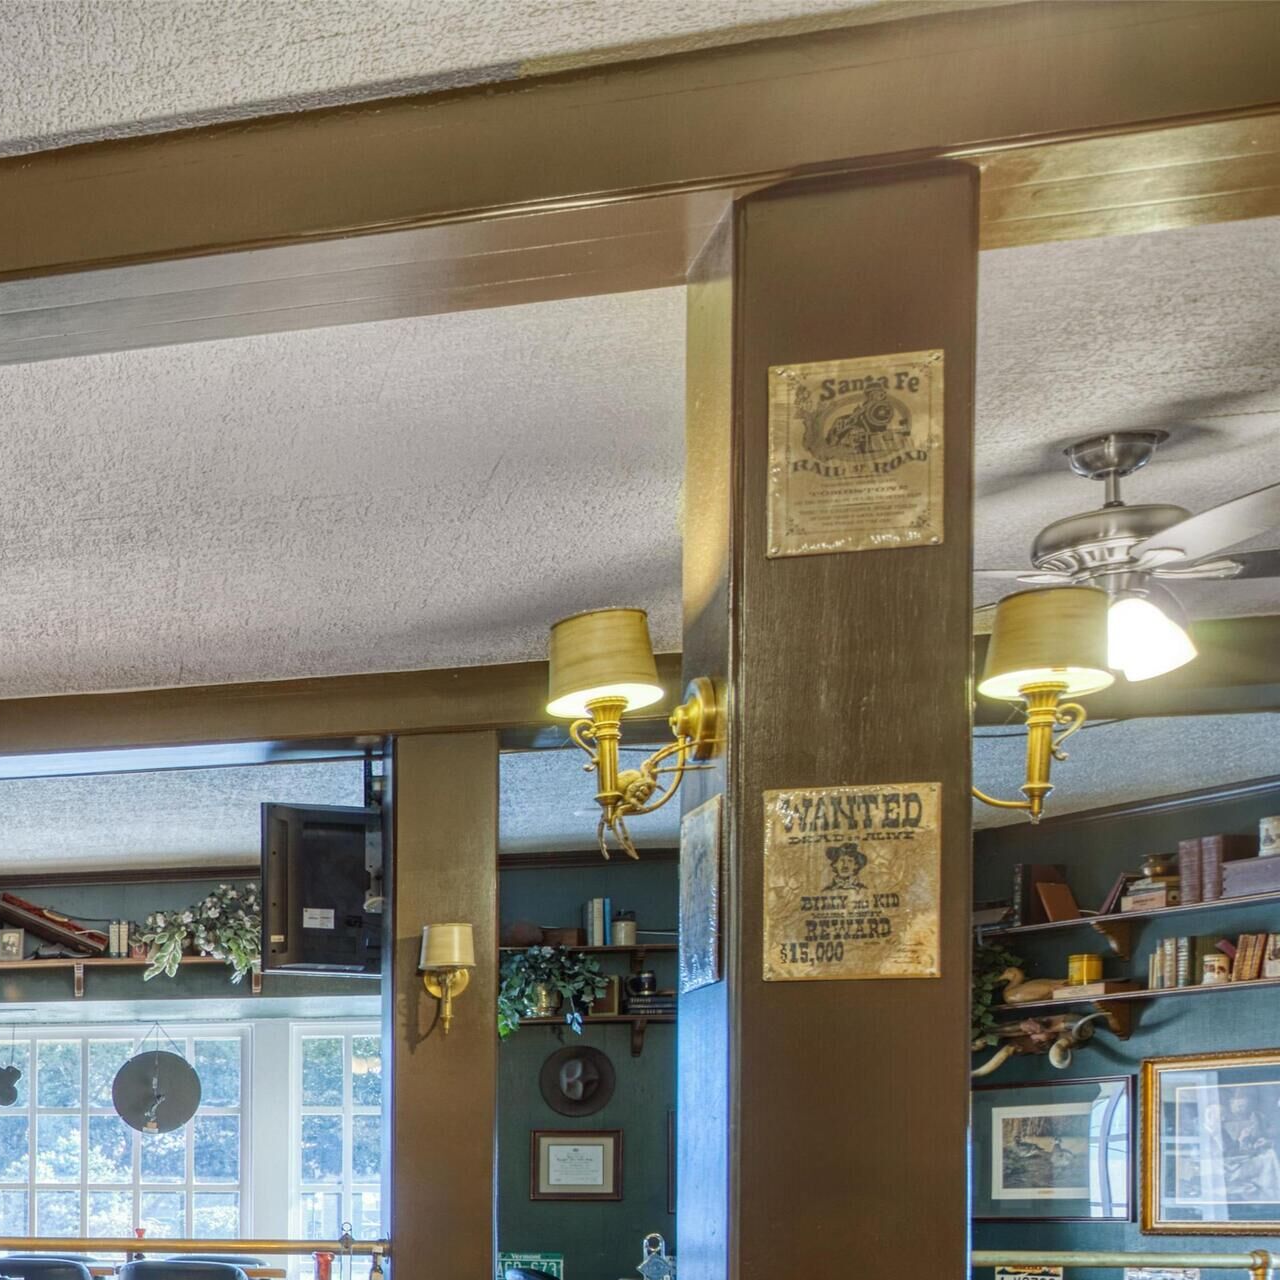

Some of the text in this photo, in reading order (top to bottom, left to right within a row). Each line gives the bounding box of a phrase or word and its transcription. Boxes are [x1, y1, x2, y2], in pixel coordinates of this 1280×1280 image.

[820, 371, 920, 401] Santa Fe
[873, 450, 927, 473] ROAD
[783, 792, 924, 833] WANTED
[788, 835, 844, 845] DEAD
[863, 831, 915, 842] ALIVE
[801, 896, 848, 911] BILLY
[873, 893, 900, 908] KID
[805, 918, 892, 942] REWARD
[780, 941, 844, 967] $15,000
